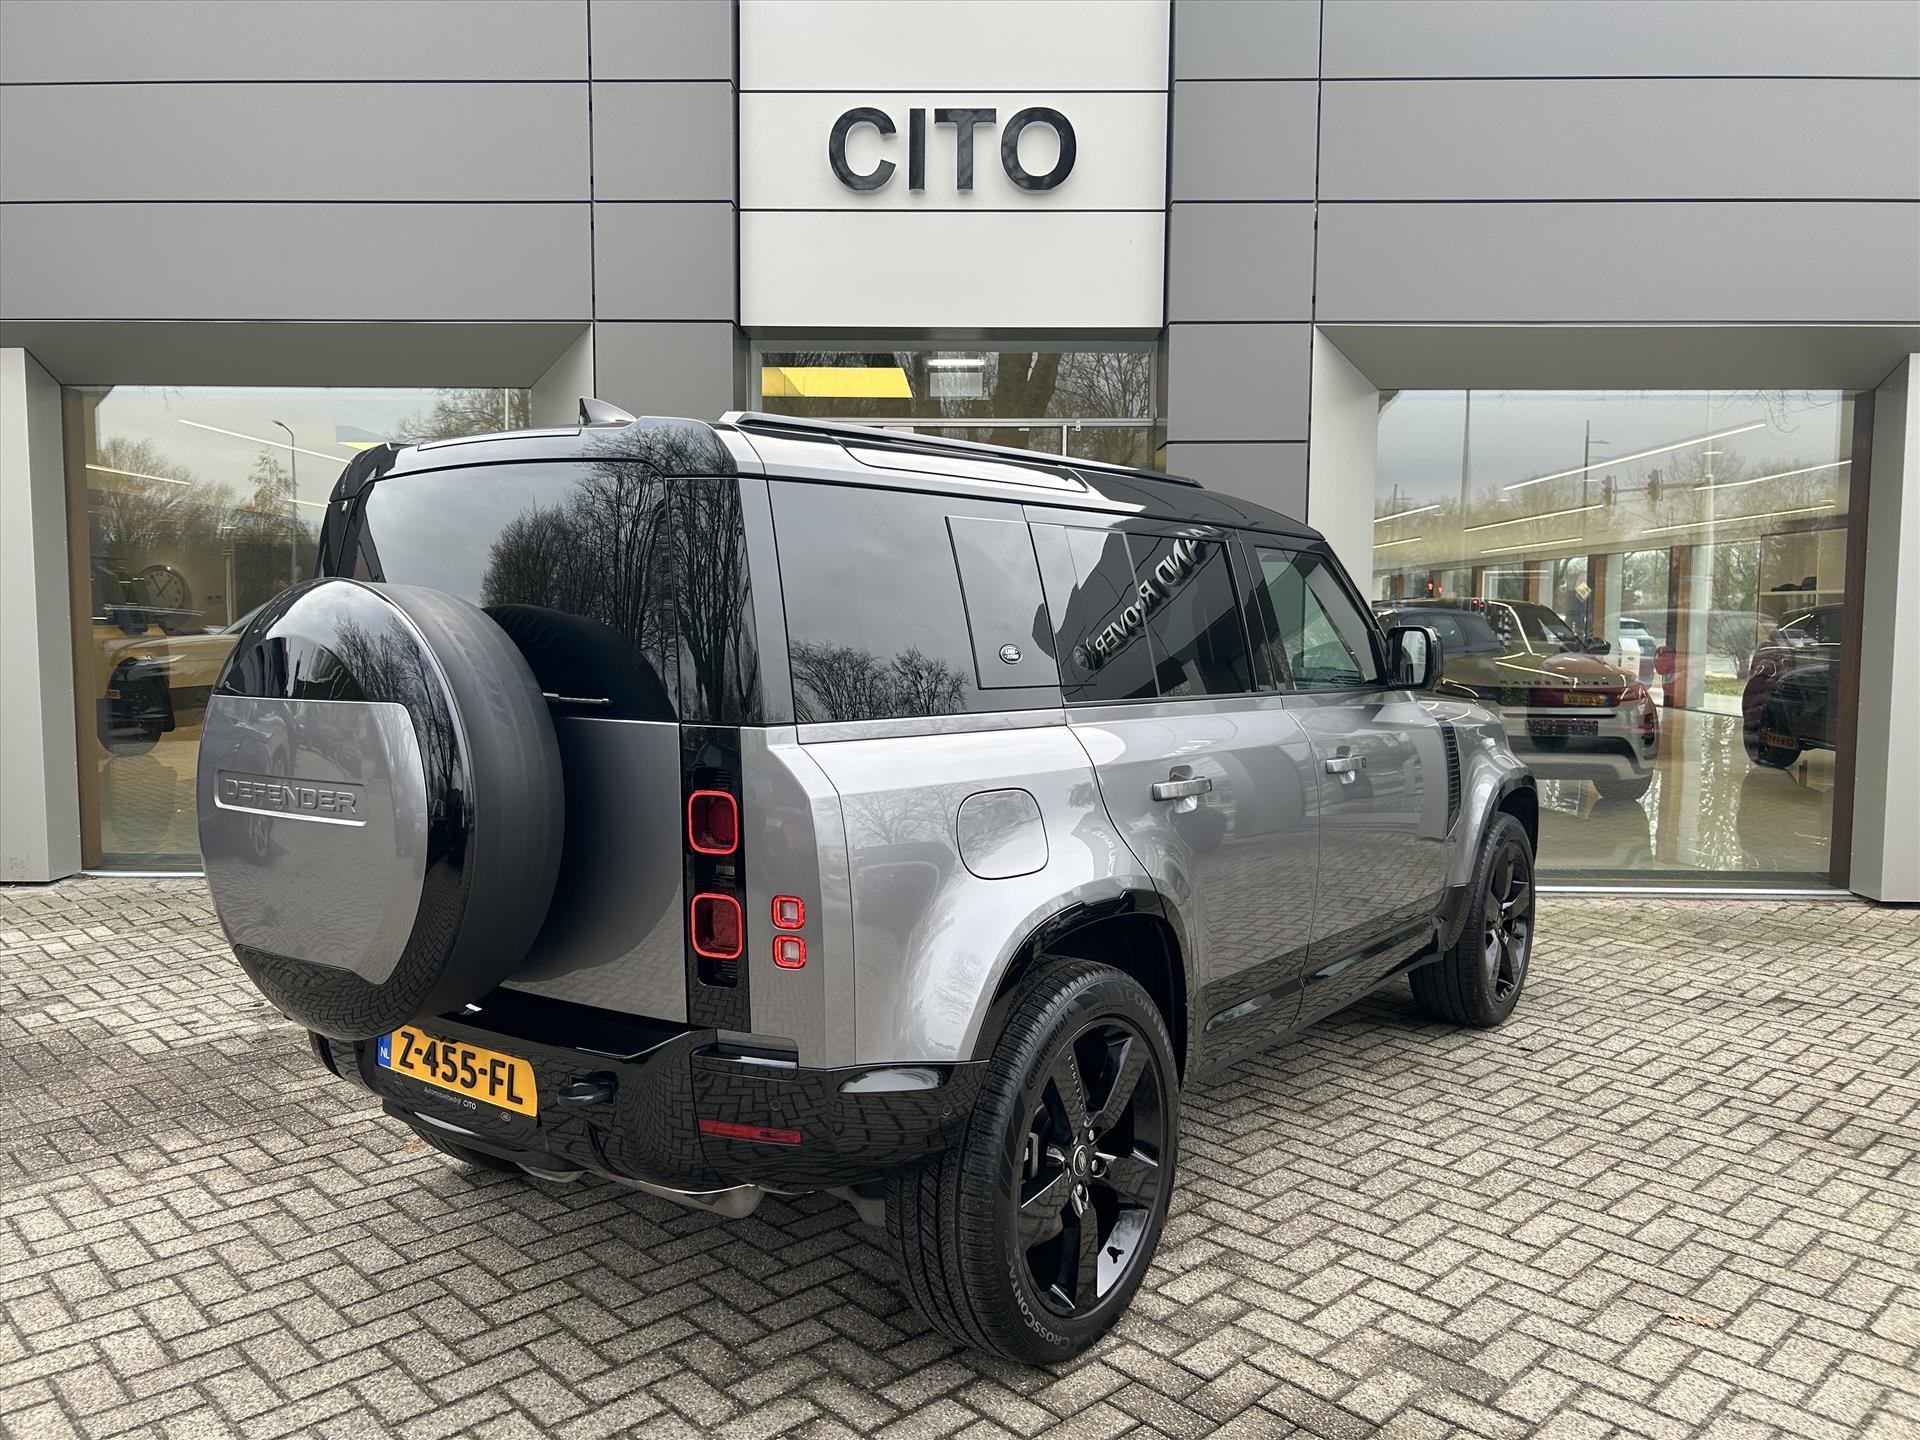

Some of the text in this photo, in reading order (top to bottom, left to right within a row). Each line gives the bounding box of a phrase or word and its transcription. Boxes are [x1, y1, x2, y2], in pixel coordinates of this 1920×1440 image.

[828, 106, 1077, 191] CITO
[225, 778, 357, 814] DEFENDER
[380, 1046, 390, 1060] NL
[399, 1030, 524, 1106] Z-455-FL
